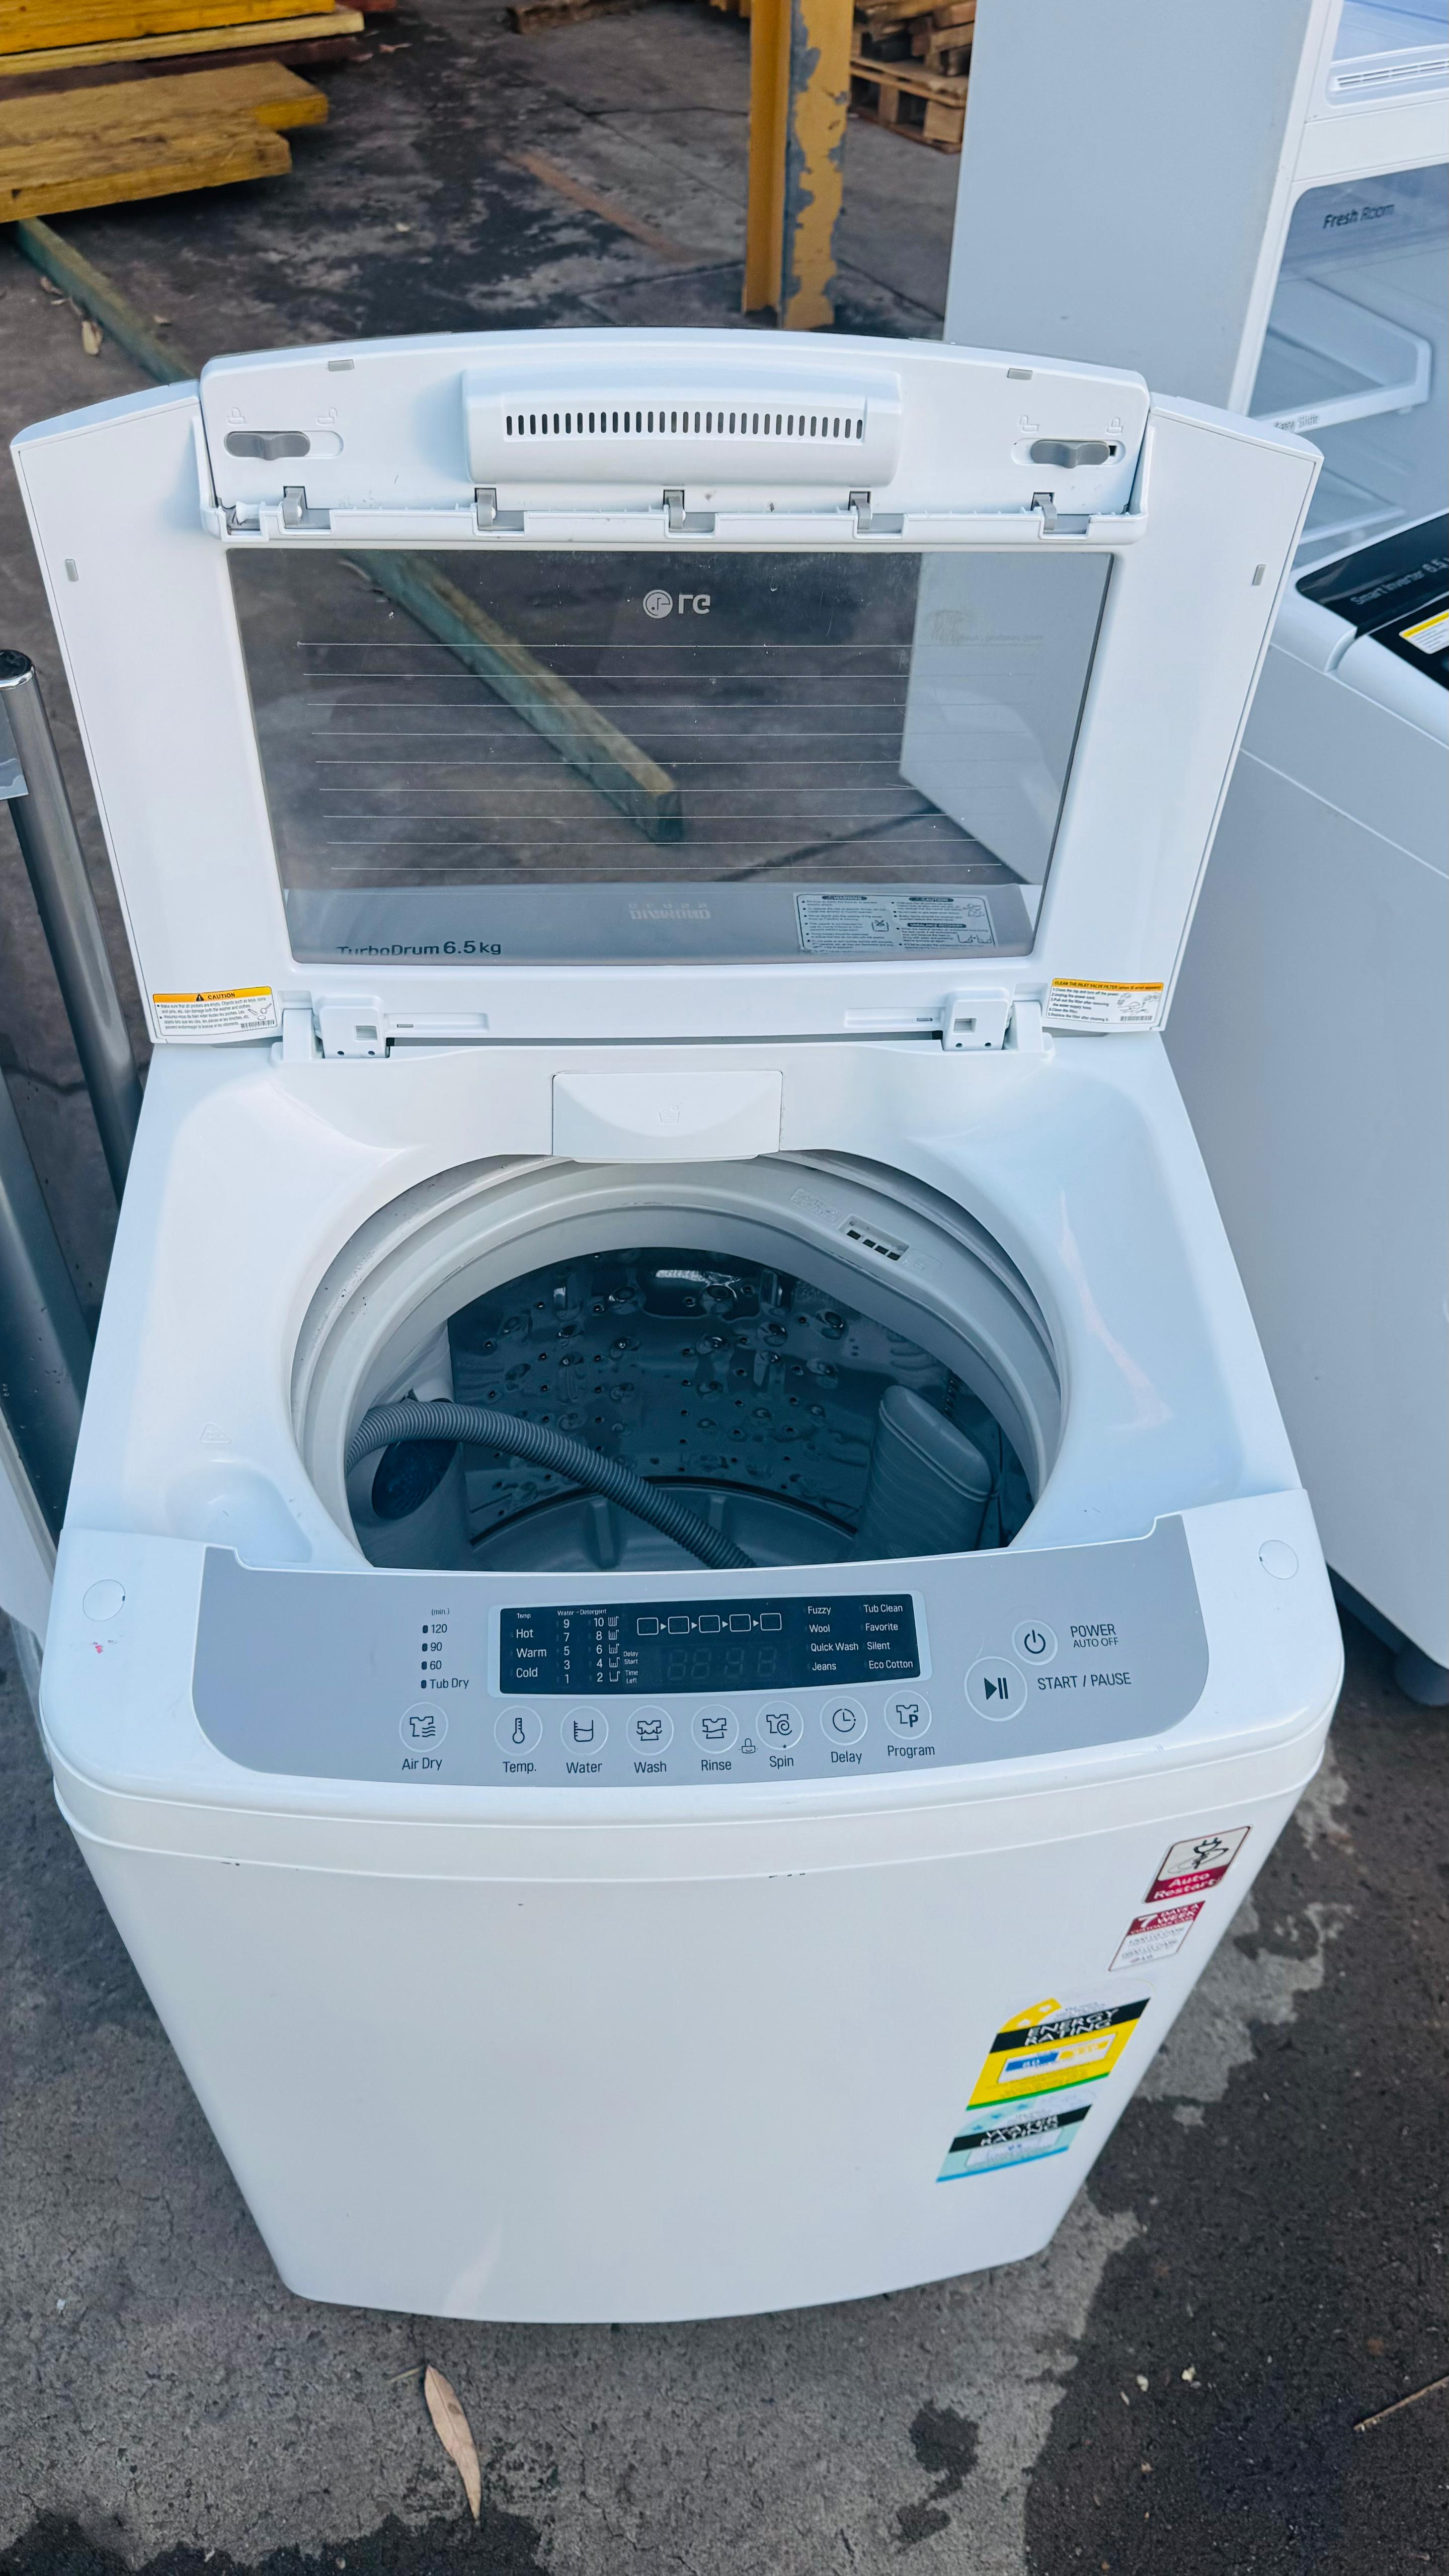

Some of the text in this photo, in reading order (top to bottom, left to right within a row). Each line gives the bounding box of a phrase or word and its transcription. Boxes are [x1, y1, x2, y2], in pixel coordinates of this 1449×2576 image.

[1323, 204, 1395, 228] Fresh Room
[443, 940, 476, 954] 6.5
[479, 942, 501, 955] kg
[431, 1607, 450, 1616] (min.)
[808, 1606, 831, 1615] Fuzzy
[863, 1603, 903, 1613] Tub Clean
[564, 1618, 604, 1628] 9 10
[809, 1624, 830, 1633] Wool
[865, 1623, 899, 1632] Favorite
[431, 1624, 447, 1634] 120
[516, 1628, 534, 1639] Hot
[1070, 1624, 1116, 1637] POWER
[564, 1631, 602, 1642] 7 8
[430, 1642, 443, 1652] 90
[811, 1642, 859, 1652] Quick Wash
[867, 1641, 891, 1650] Silent
[1073, 1637, 1119, 1648] AUTO OFF
[516, 1648, 547, 1658] Warm
[564, 1644, 602, 1655] 5 6
[430, 1660, 442, 1670] 60
[564, 1658, 603, 1669] 3 4
[812, 1661, 837, 1671] Jeans
[868, 1659, 914, 1669] Eco Cotton
[516, 1667, 538, 1678] Cold
[565, 1672, 603, 1684] 1 2
[430, 1678, 469, 1689] Tub Dry
[1037, 1675, 1078, 1691] START
[1091, 1672, 1132, 1687] PAUSE
[831, 1750, 862, 1764] Delay
[888, 1744, 935, 1759] Program
[402, 1758, 442, 1772] Air Dry
[503, 1761, 537, 1774] Temp.
[566, 1761, 602, 1774] Water
[634, 1761, 667, 1774] Wash
[701, 1759, 732, 1772] Rinse
[769, 1755, 794, 1770] Spin
[1168, 1873, 1210, 1888] Auto
[1138, 1914, 1158, 1928] 7
[1027, 2008, 1118, 2036] ENERGY
